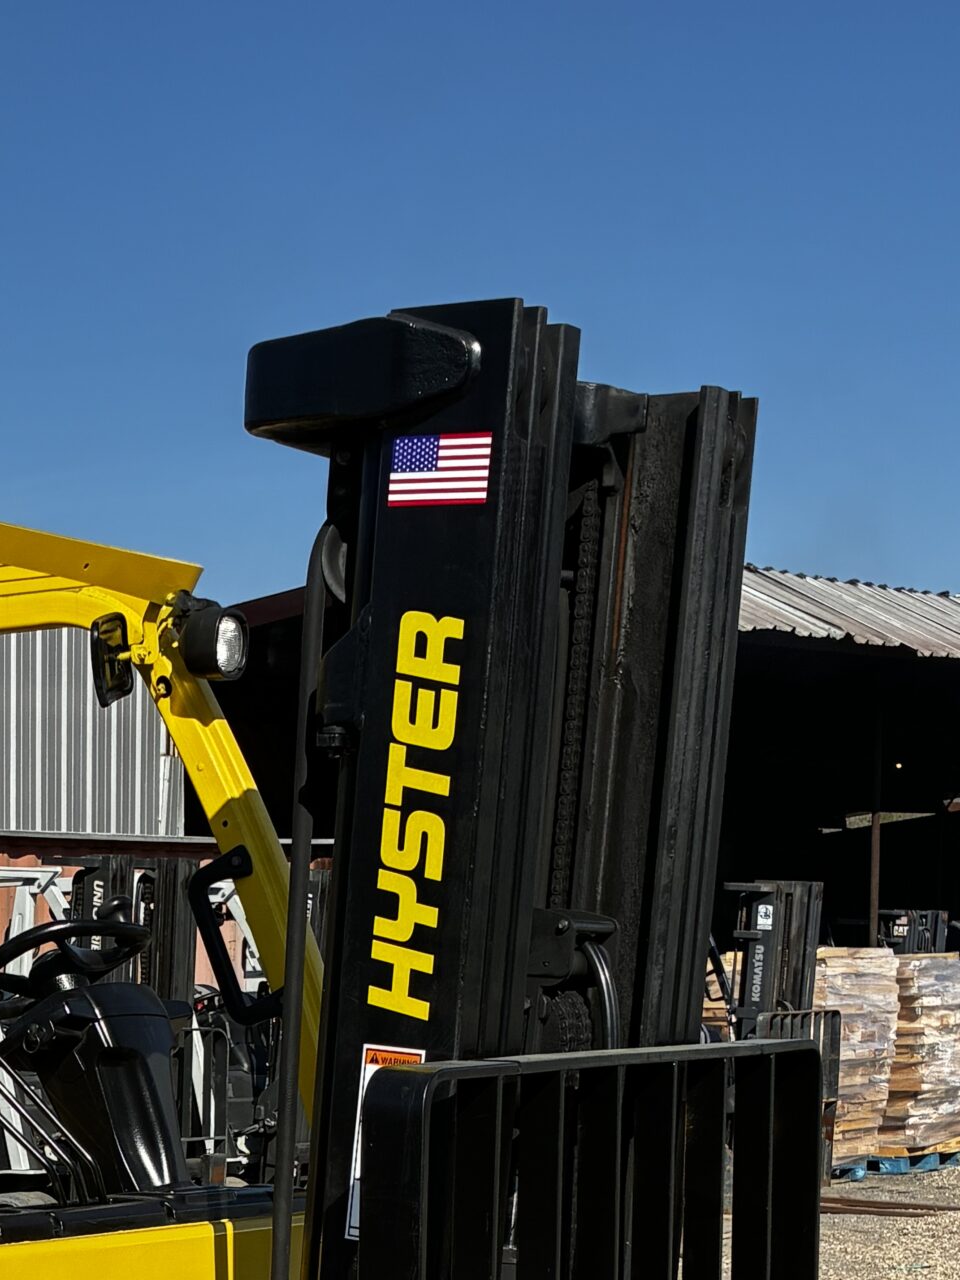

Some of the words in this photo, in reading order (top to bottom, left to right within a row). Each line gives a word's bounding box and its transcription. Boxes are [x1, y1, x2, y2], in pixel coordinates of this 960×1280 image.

[368, 611, 465, 1021] HYSTER
[893, 925, 909, 937] CAT
[751, 944, 765, 1002] KOMATSU
